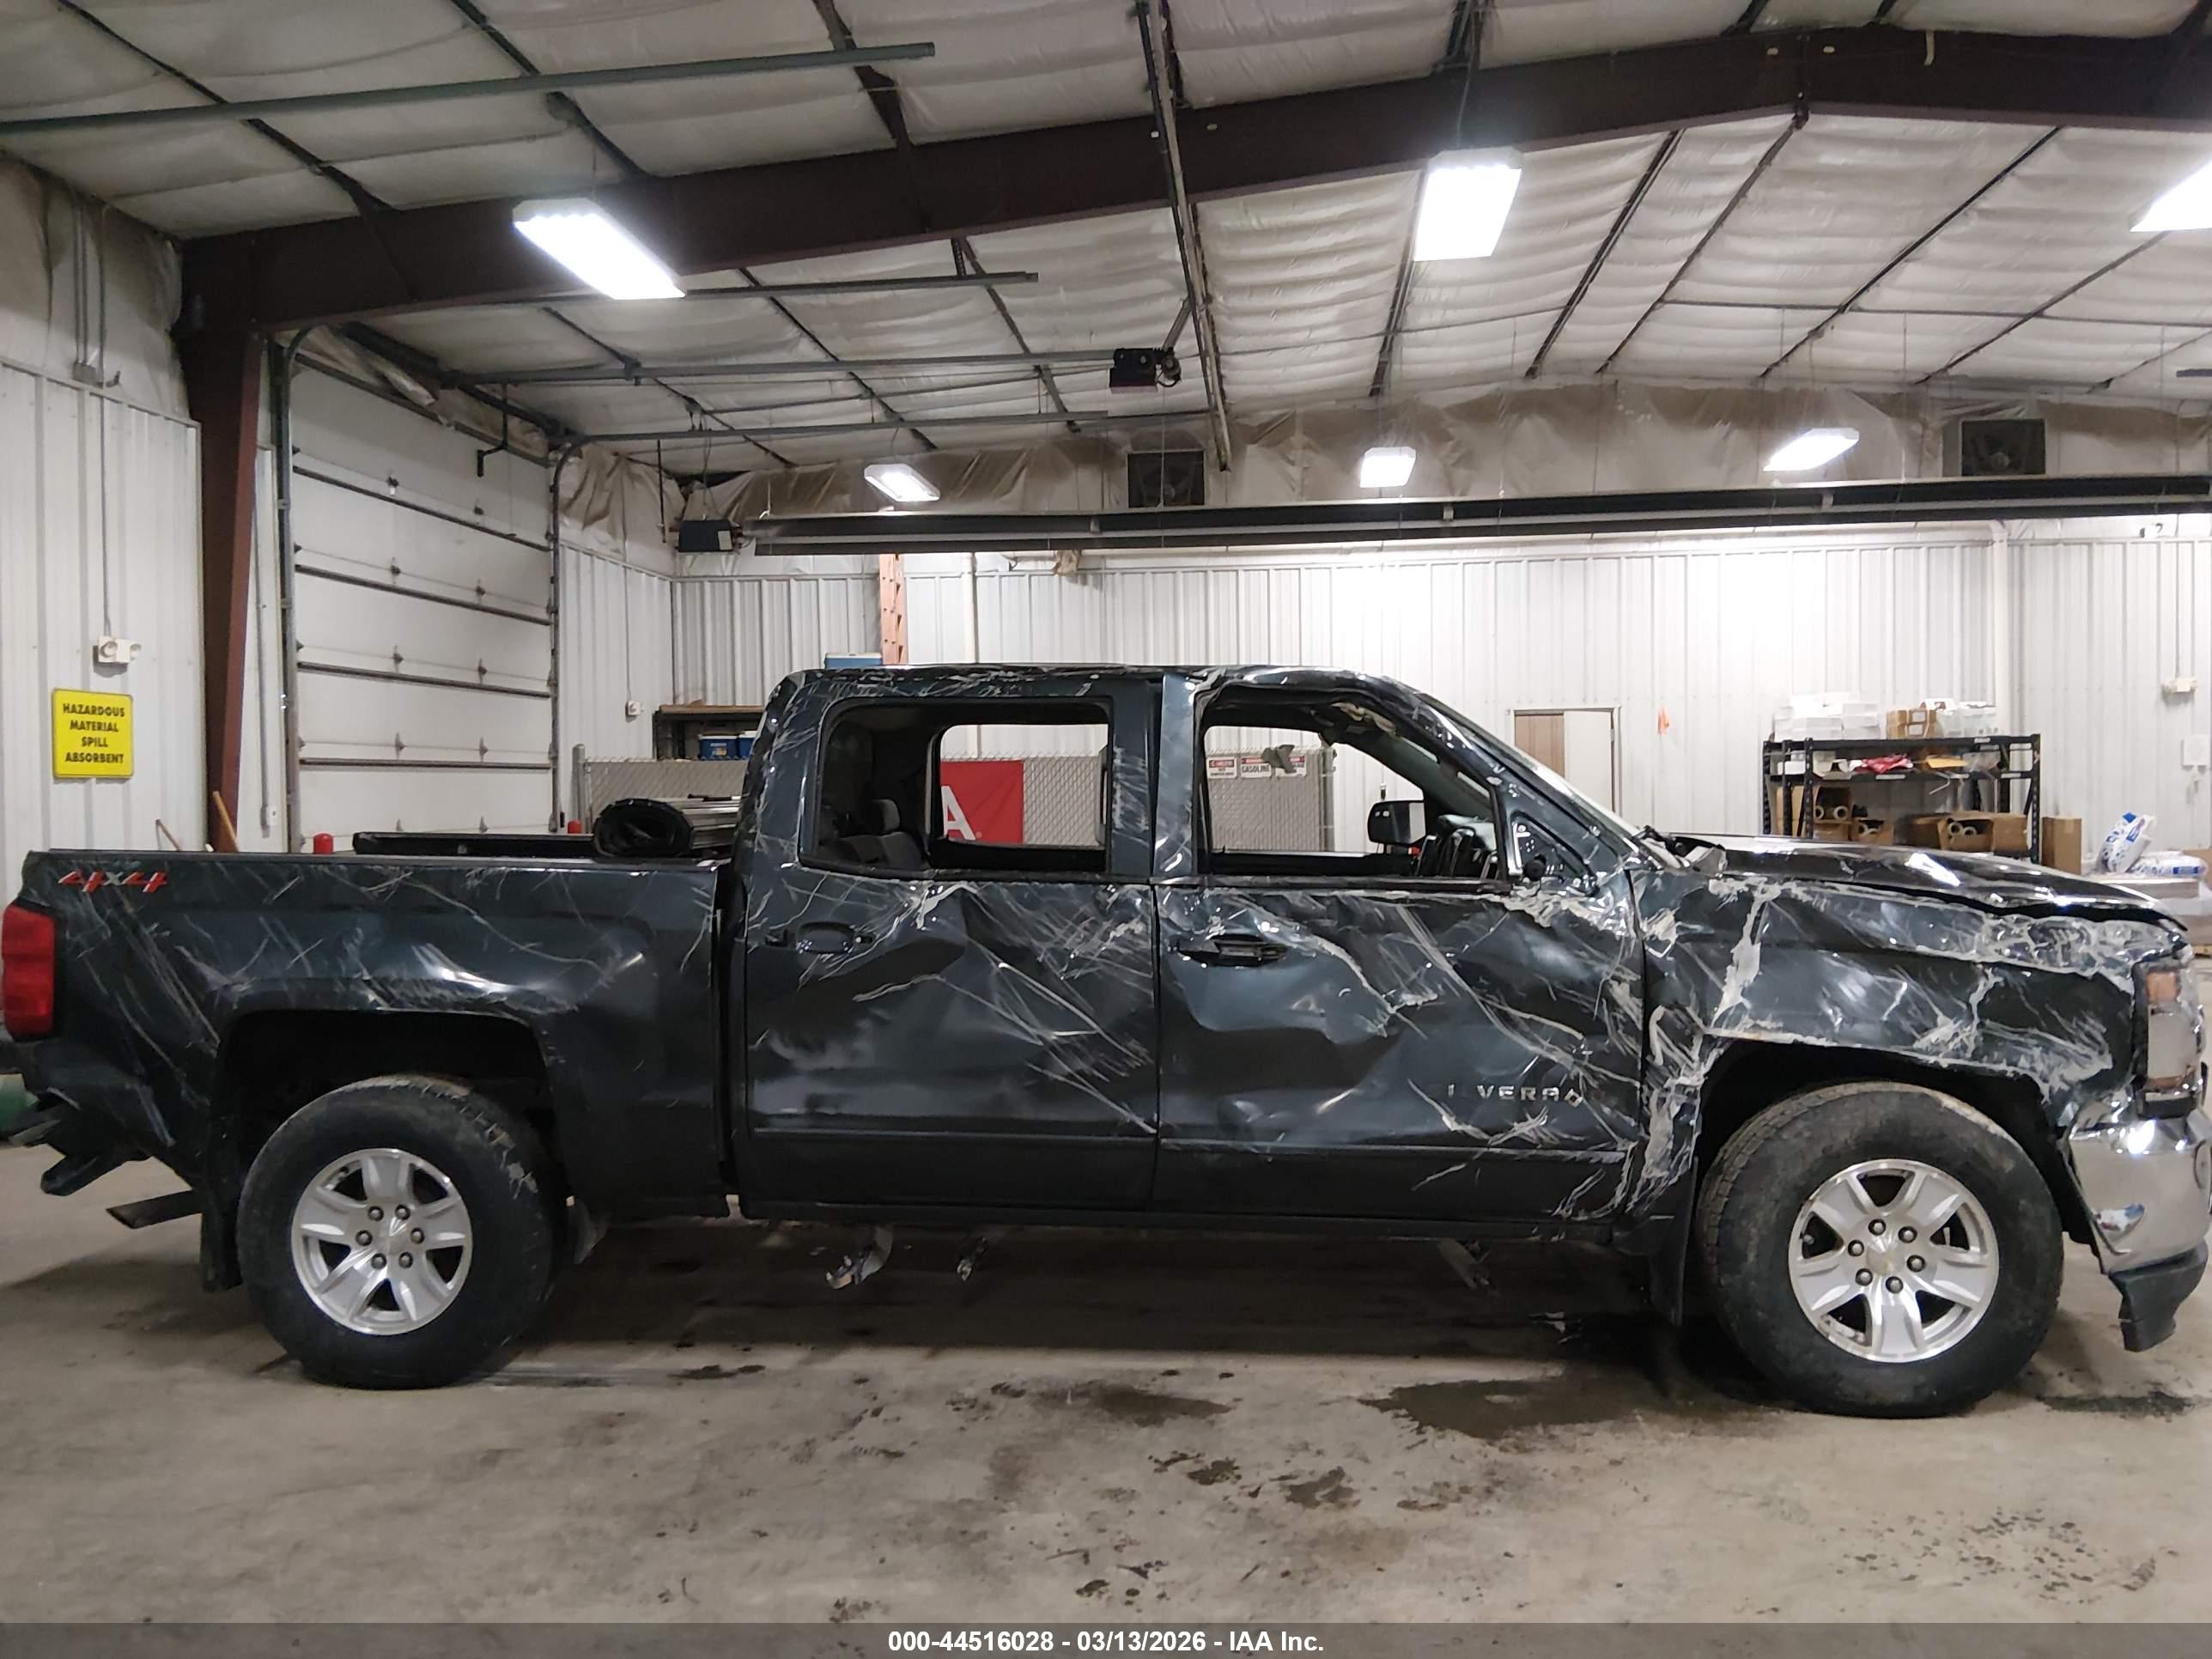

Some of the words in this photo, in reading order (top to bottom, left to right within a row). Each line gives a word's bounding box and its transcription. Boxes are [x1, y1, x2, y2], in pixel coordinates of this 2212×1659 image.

[63, 703, 125, 717] HAZARDOUS
[70, 720, 118, 732] MATERIAL
[82, 736, 108, 748] SPILL
[65, 751, 124, 763] ABSORBENT
